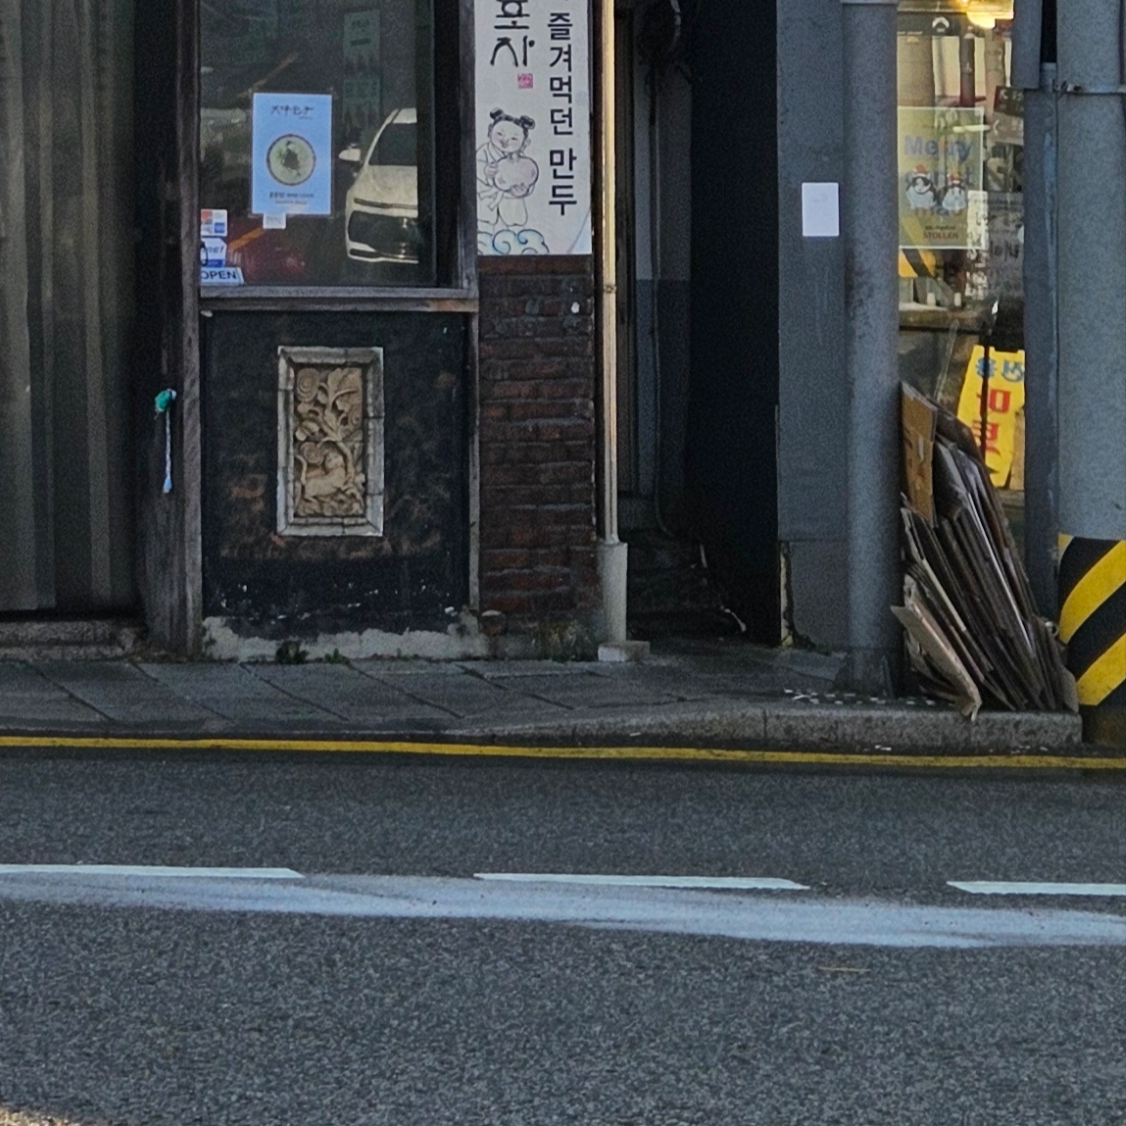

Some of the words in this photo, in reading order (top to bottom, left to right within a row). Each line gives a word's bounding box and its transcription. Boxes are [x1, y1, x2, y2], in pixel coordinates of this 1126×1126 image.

[547, 11, 574, 136] 즐겨먹던
[548, 147, 578, 216] 만두
[201, 270, 237, 280] OPEN
